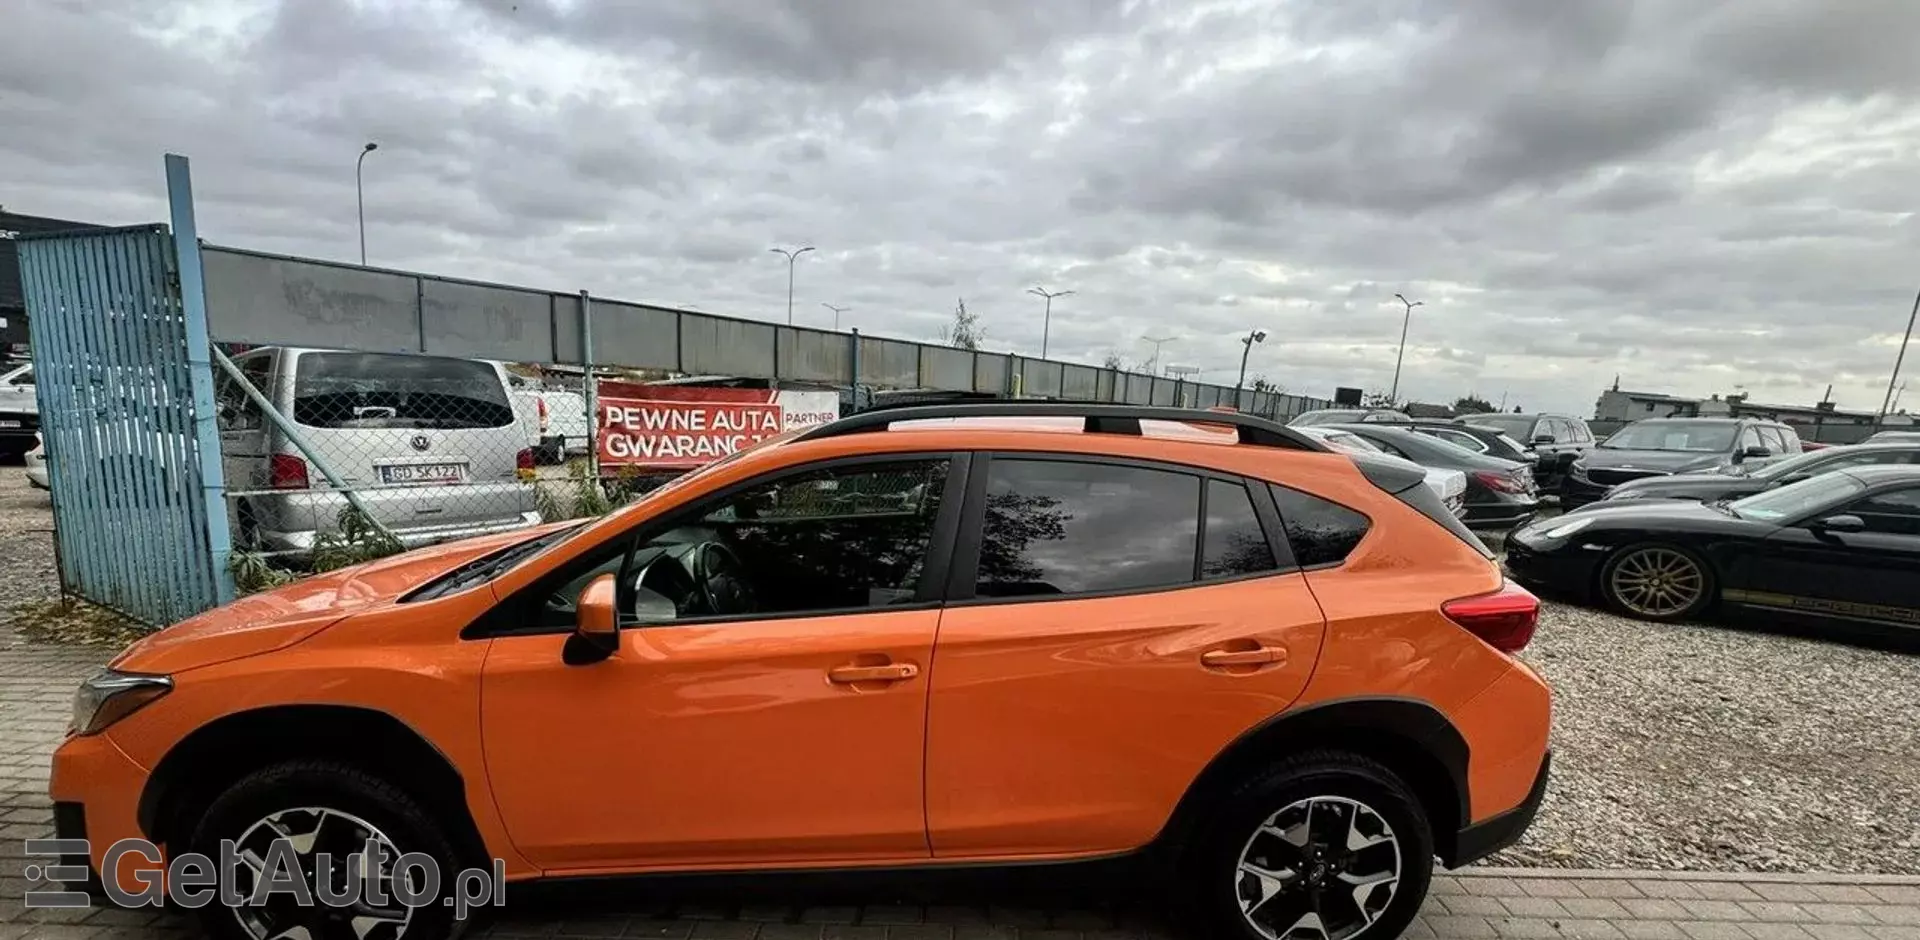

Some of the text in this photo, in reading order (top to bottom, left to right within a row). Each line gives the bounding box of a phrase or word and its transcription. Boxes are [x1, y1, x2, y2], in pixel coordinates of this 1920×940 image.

[604, 406, 779, 431] PEWNE AUTA
[785, 412, 834, 424] PARTNER
[605, 433, 776, 457] GWARANC
